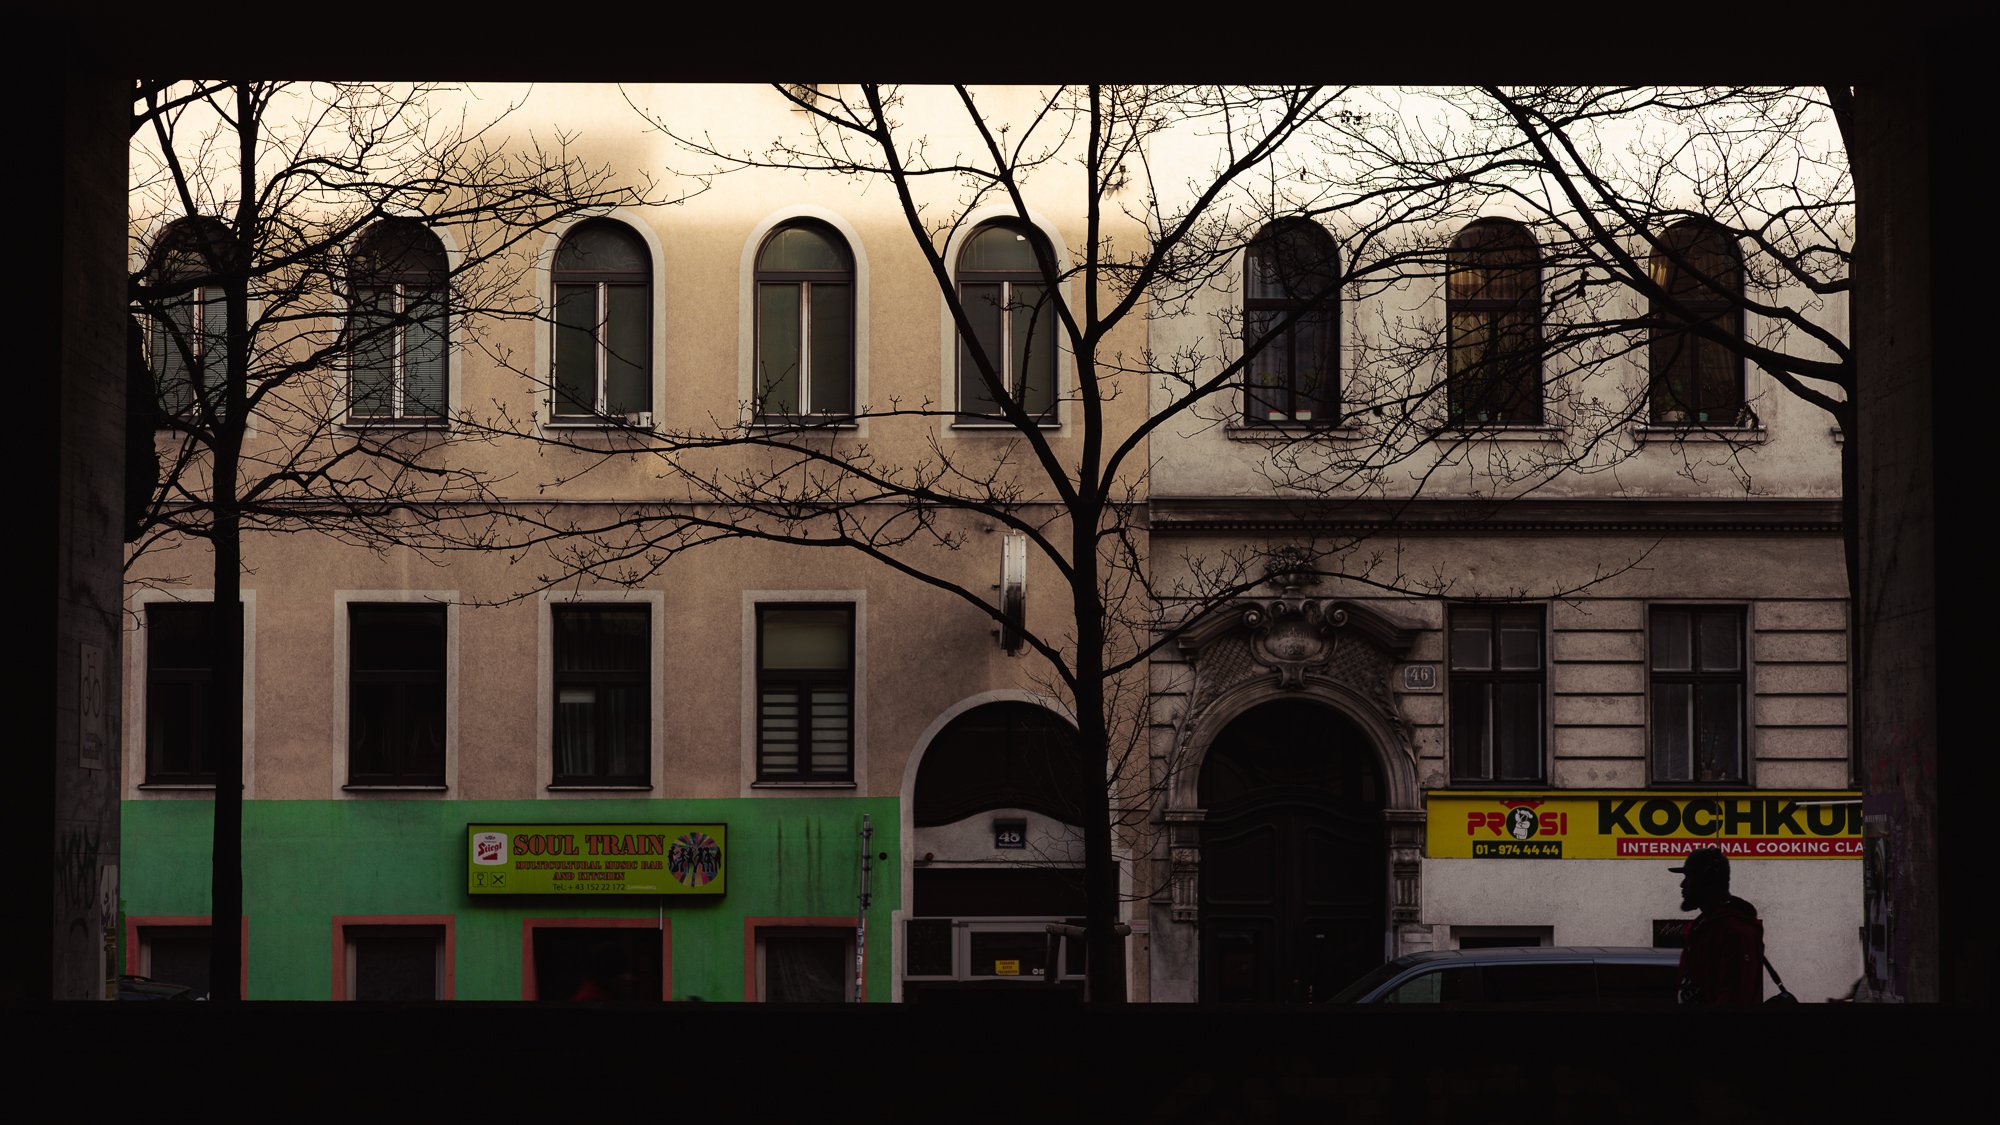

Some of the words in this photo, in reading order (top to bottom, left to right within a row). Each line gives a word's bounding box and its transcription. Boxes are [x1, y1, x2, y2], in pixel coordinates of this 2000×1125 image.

[1410, 668, 1429, 681] 46
[1467, 807, 1568, 840] PROSI
[478, 841, 502, 857] Stiegl
[512, 834, 580, 856] SOUL
[584, 834, 666, 856] TRAIN
[1523, 844, 1540, 855] 44
[1542, 844, 1559, 855] 44
[1755, 842, 1830, 854] COOKING
[515, 860, 601, 870] MULTICULTURAL
[605, 860, 638, 870] MUSIC
[640, 860, 664, 870] BAR
[552, 871, 575, 881] AND
[577, 871, 626, 881] KITCHEN
